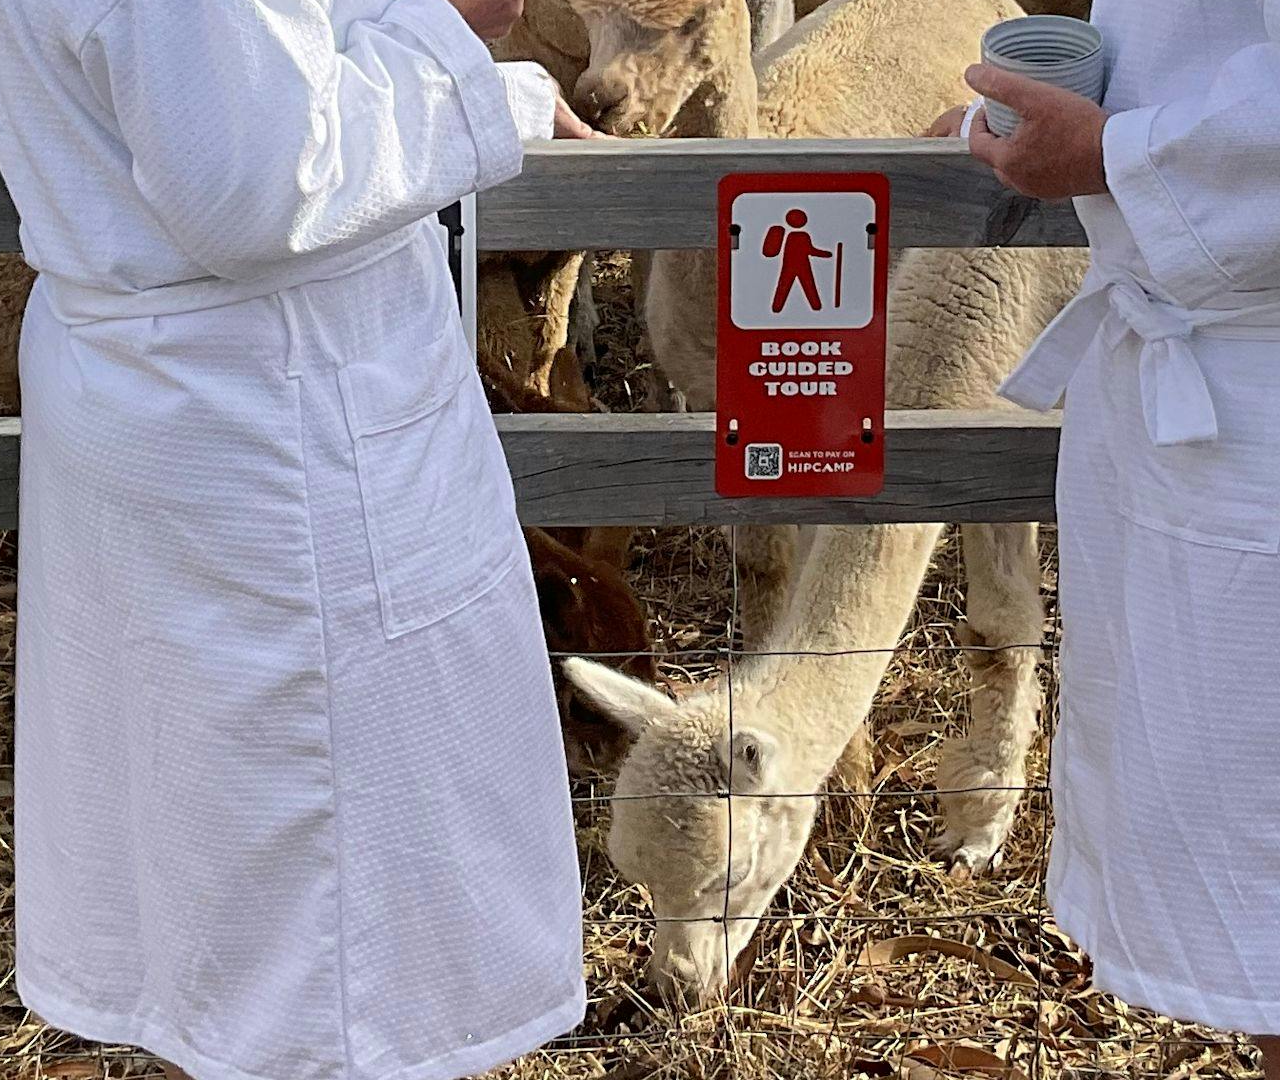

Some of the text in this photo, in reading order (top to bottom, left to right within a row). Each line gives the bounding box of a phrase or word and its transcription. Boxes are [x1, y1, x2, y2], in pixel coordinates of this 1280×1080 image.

[761, 341, 842, 357] BOOK
[748, 361, 854, 377] GUIDED
[764, 381, 838, 397] TOUR
[788, 450, 856, 459] SCAN TO PAY ON
[787, 462, 855, 473] HIPCAMP
